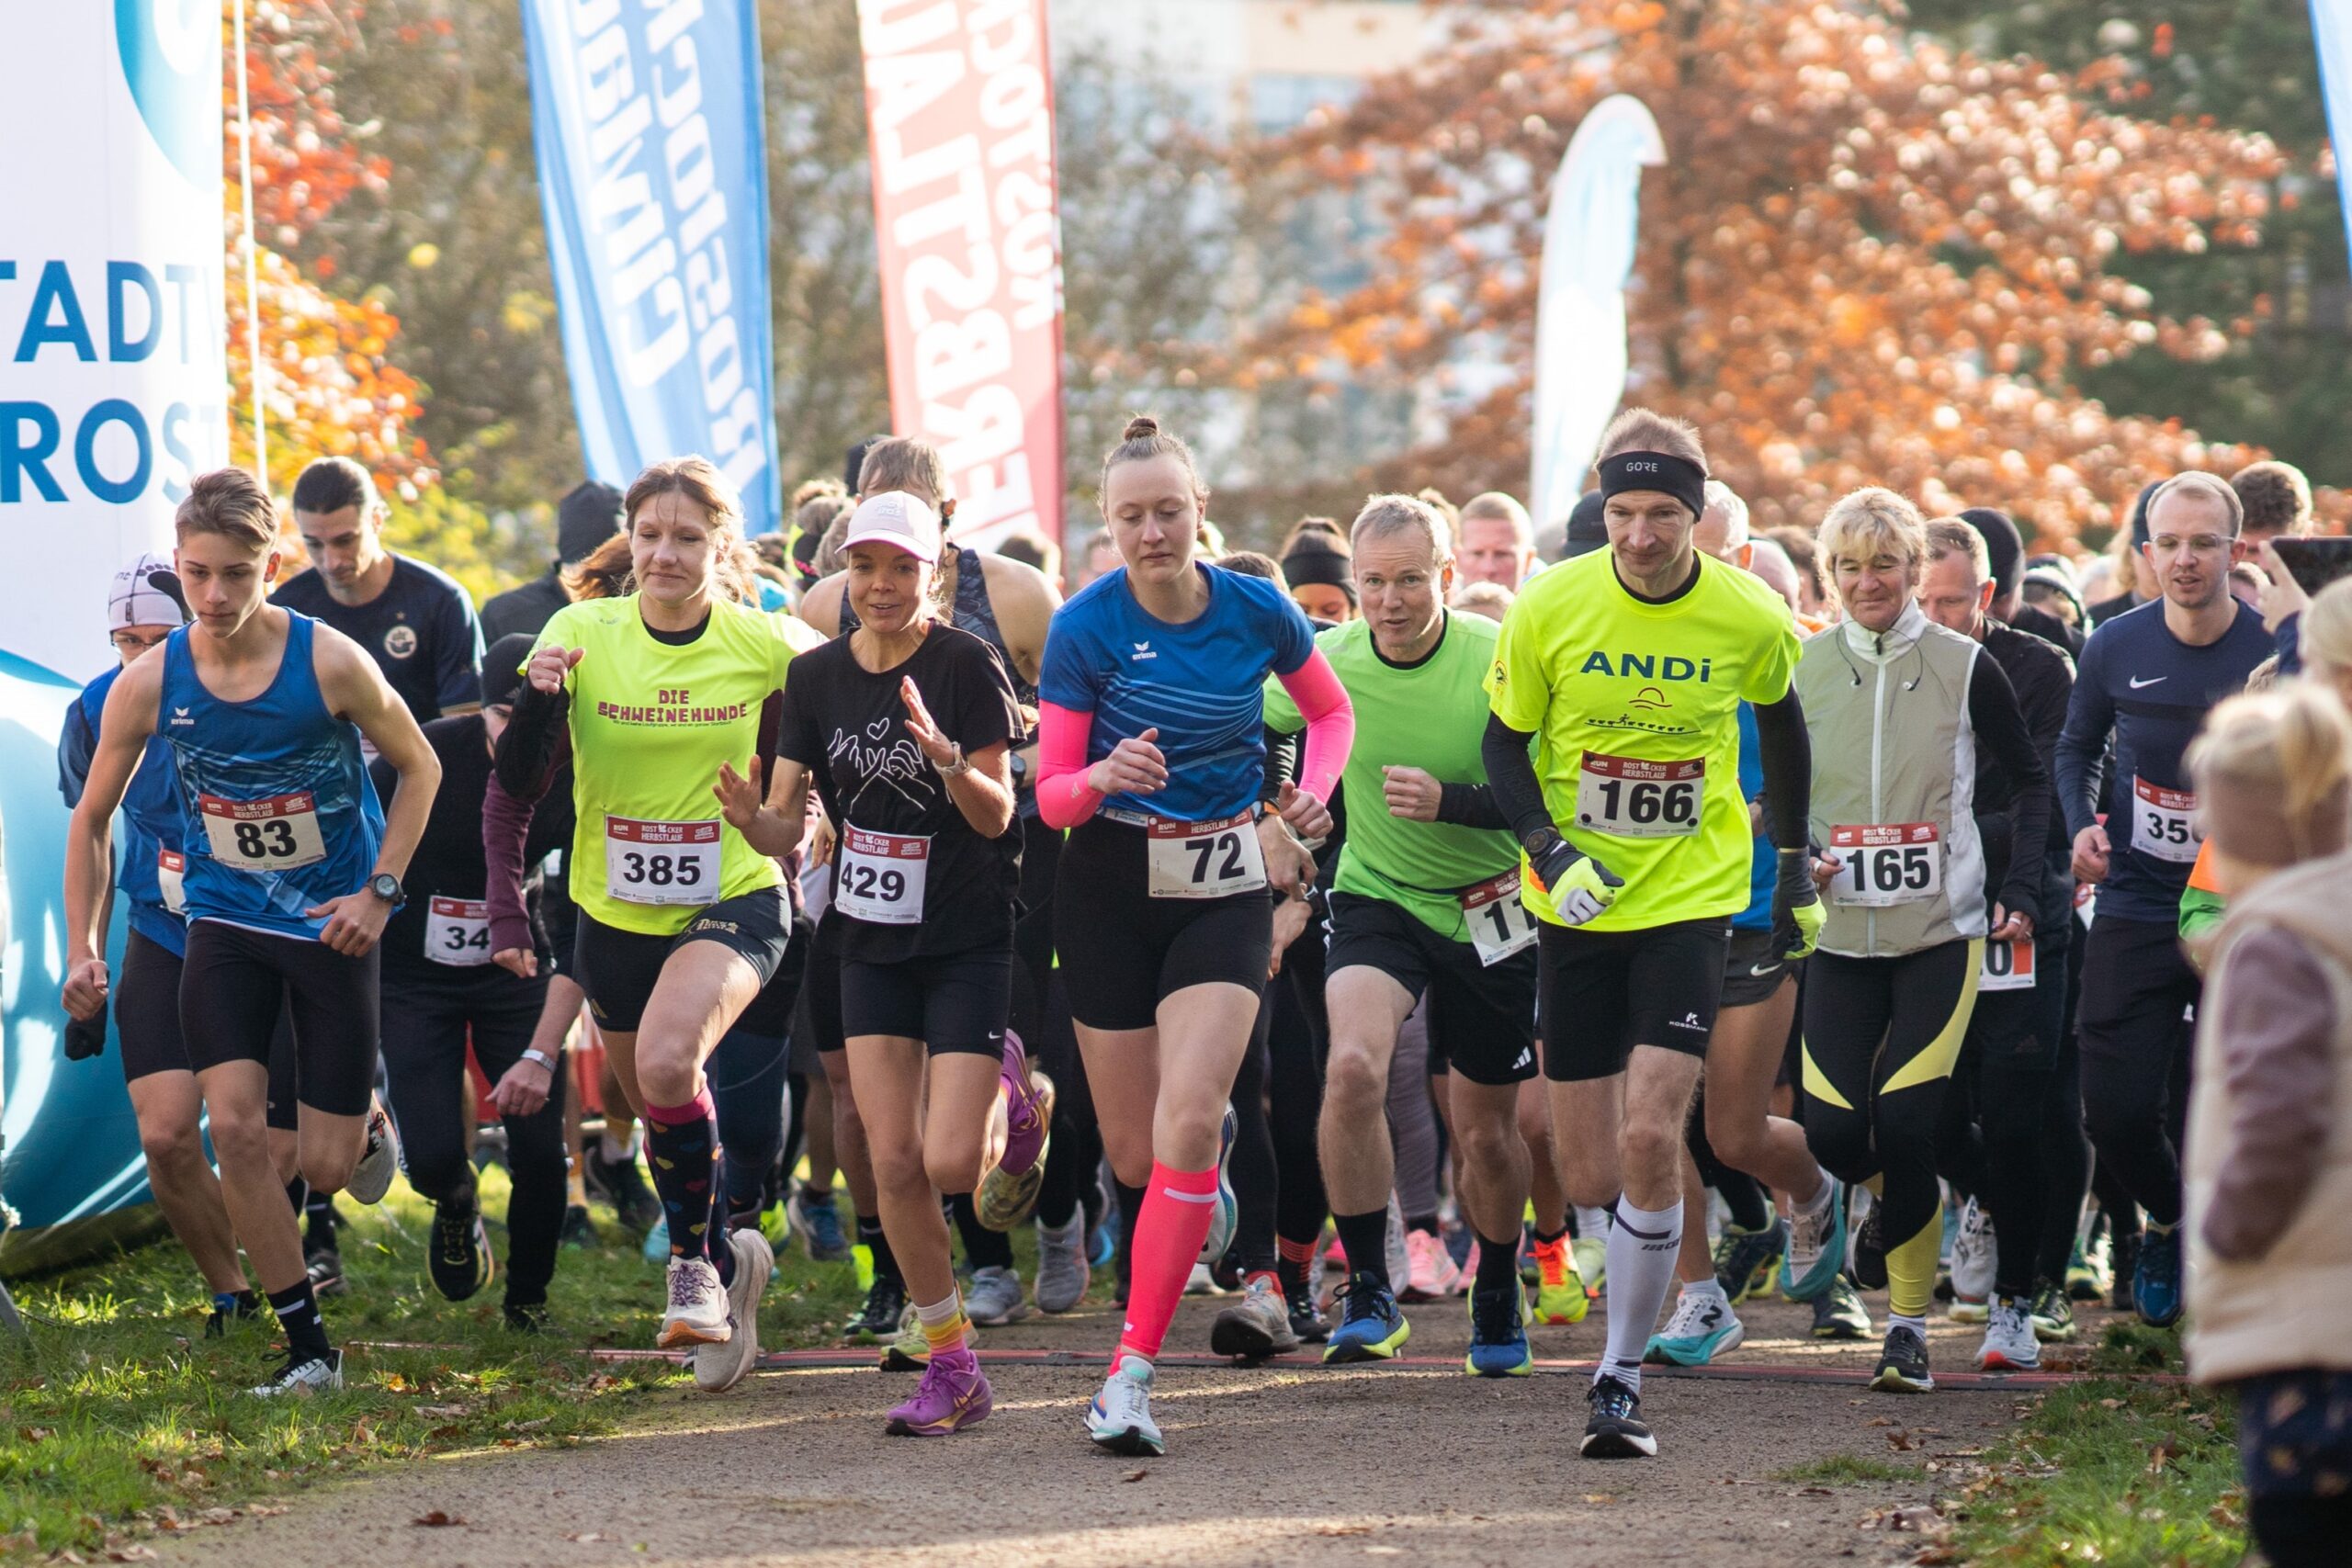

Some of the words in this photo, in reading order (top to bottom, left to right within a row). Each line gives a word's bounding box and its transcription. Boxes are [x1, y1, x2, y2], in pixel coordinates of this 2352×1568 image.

[1625, 461, 1659, 473] GORE
[1579, 650, 1712, 683] ANDi
[659, 690, 690, 705] DIE
[597, 701, 748, 723] SCHWEINEHUNDE
[1622, 769, 1668, 780] HERBSTLAUF
[1599, 780, 1694, 824] 166
[234, 819, 297, 858] 83
[640, 832, 684, 842] HERBSTLAUF
[1158, 822, 1177, 831] RUN
[1190, 819, 1229, 834] HERBSTLAUF
[623, 852, 701, 886] 385
[1185, 831, 1246, 884] 72
[1846, 846, 1930, 892] 165
[840, 861, 905, 902] 429
[444, 925, 491, 951] 34
